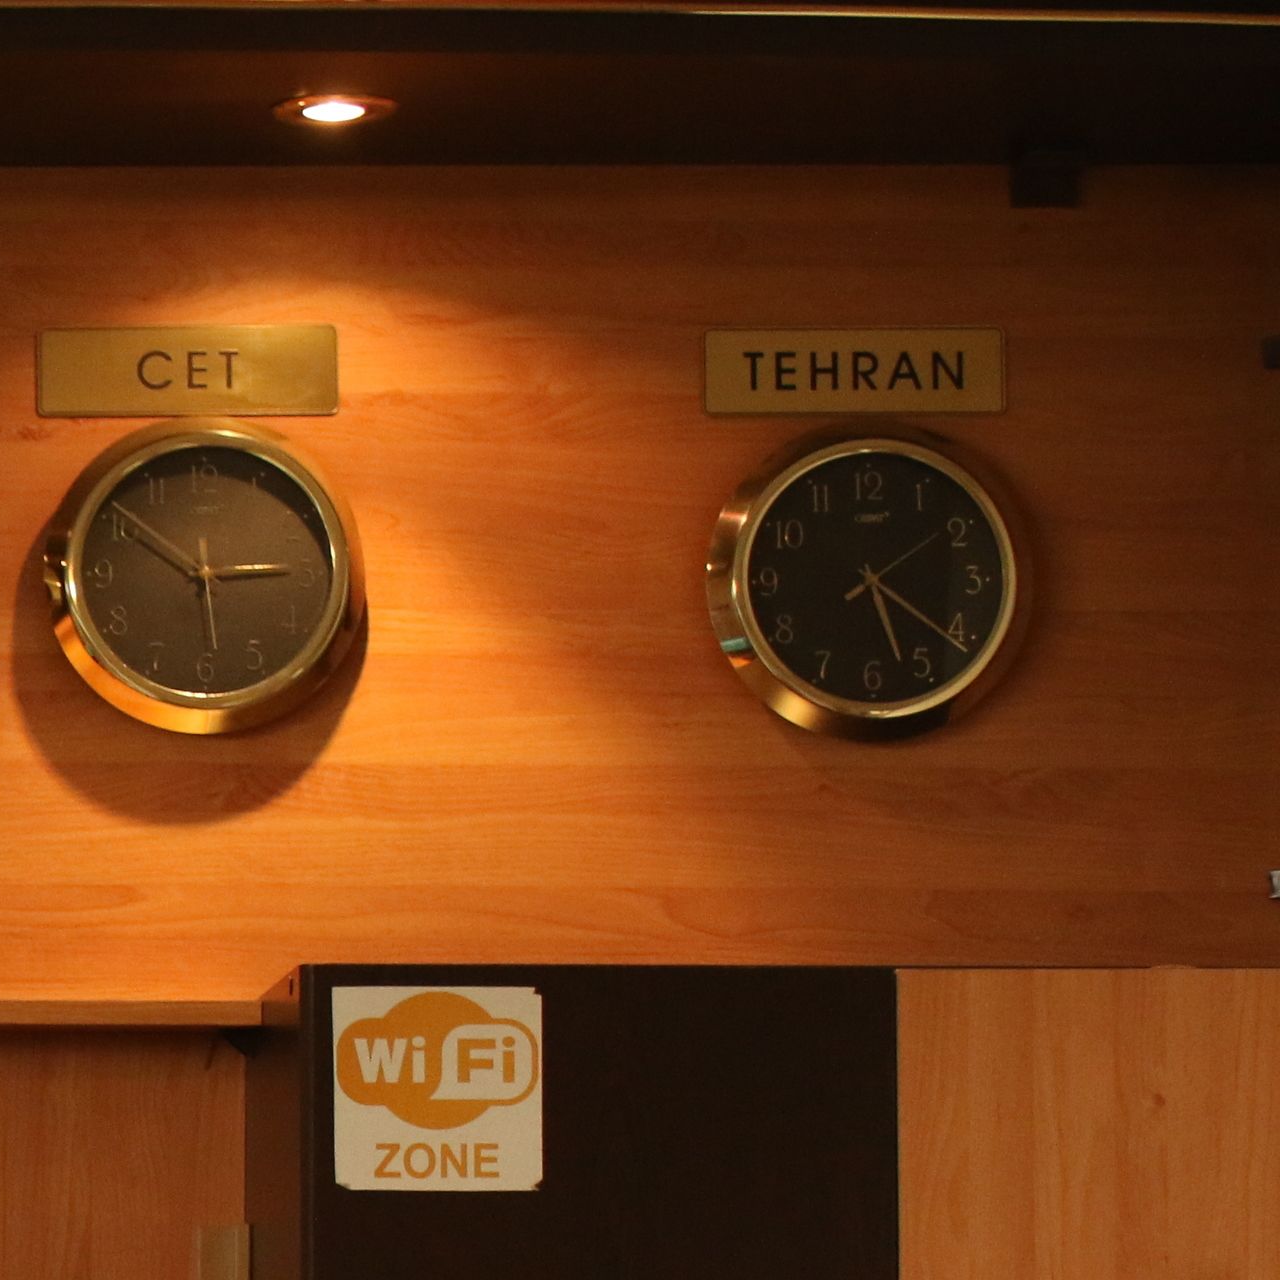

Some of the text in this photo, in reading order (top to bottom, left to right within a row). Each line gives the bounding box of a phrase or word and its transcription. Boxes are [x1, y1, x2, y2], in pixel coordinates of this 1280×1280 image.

[137, 350, 239, 390] CET
[744, 351, 965, 391] TEHRAN
[148, 478, 164, 504] 11
[191, 464, 218, 493] 12
[854, 472, 883, 501] 12
[812, 484, 828, 512] 11
[915, 484, 924, 511] 1
[776, 521, 804, 549] 10
[947, 519, 968, 547] 2
[94, 561, 112, 588] 9
[760, 568, 778, 596] 9
[965, 565, 982, 594] 3
[109, 606, 128, 634] 8
[776, 615, 794, 643] 8
[949, 613, 965, 641] 4
[197, 654, 213, 682] 6
[245, 640, 264, 670] 5
[815, 650, 832, 680] 7
[913, 648, 931, 677] 5
[864, 662, 881, 690] 6
[374, 1143, 500, 1179] ZONE
